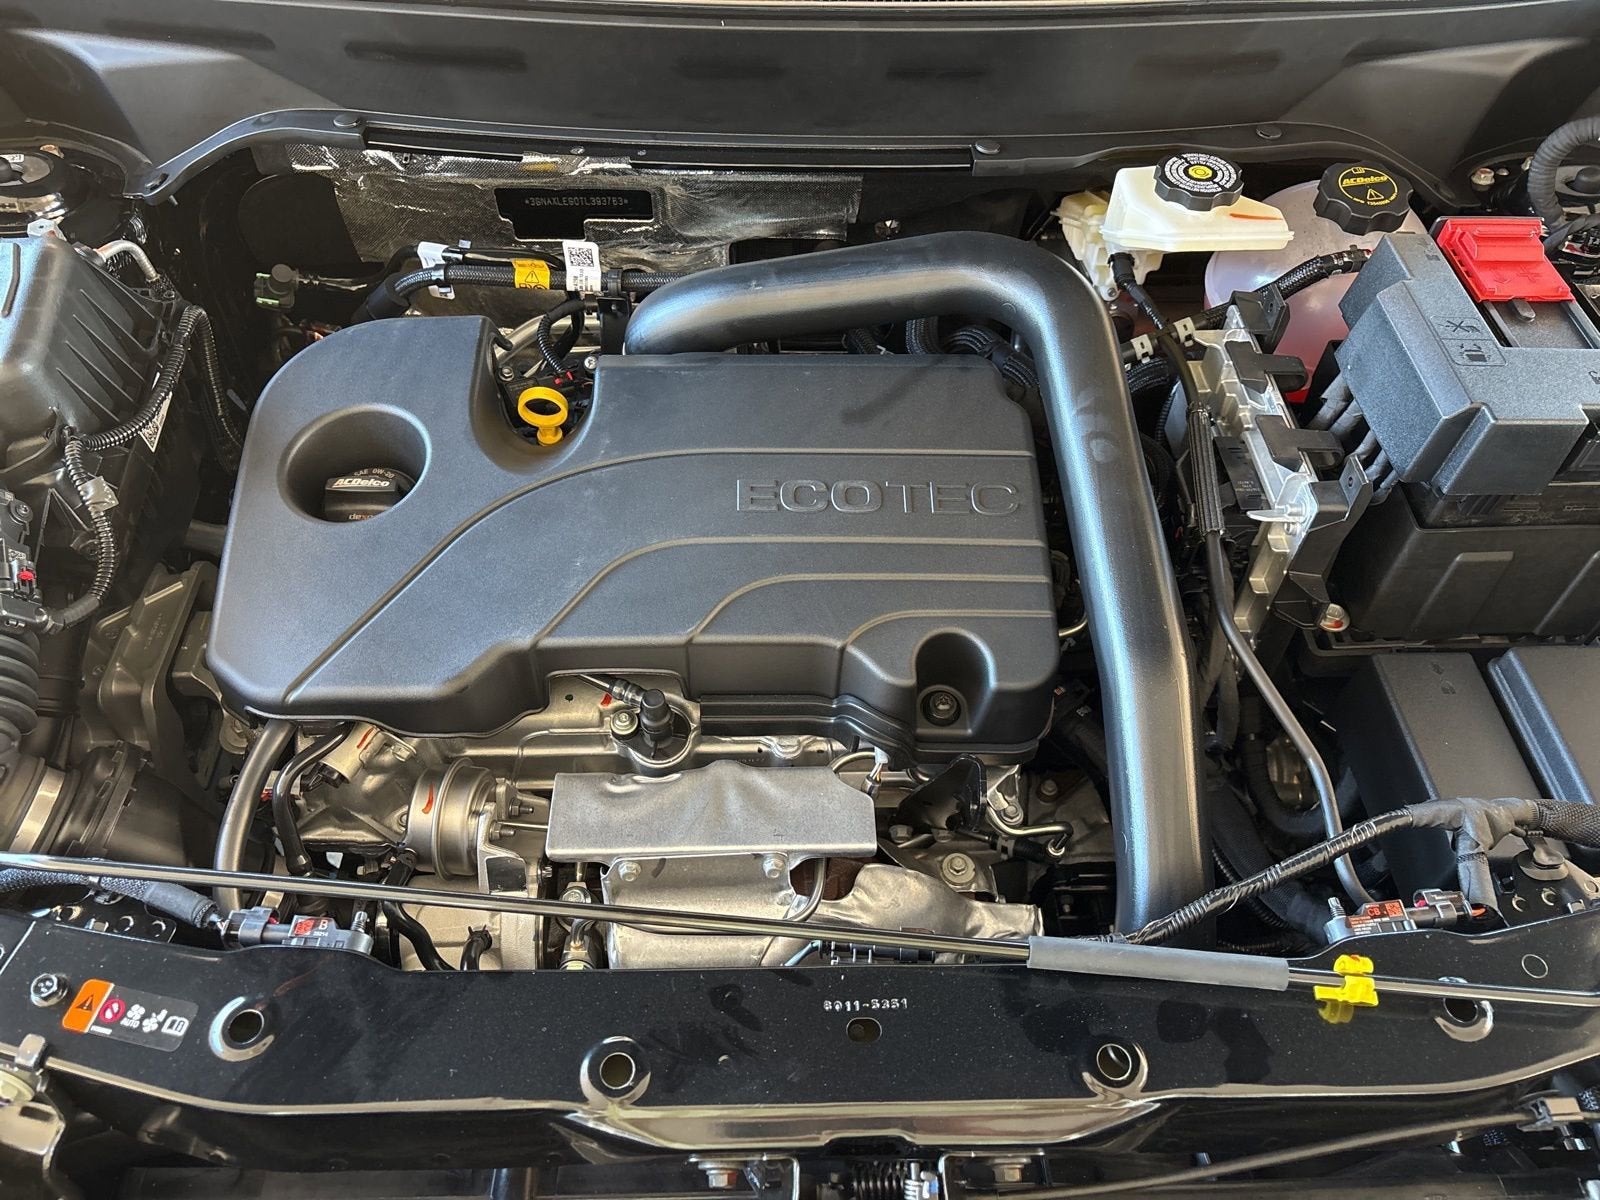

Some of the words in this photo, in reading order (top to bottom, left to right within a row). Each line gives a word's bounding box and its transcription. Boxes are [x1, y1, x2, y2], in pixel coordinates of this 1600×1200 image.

[1342, 175, 1388, 187] ACDelco
[353, 468, 369, 477] SAE
[372, 468, 396, 479] 0W-20
[332, 478, 390, 488] ACDelco
[736, 479, 1020, 516] ECOTEC
[348, 513, 375, 521] dexo
[318, 919, 329, 931] B
[119, 1017, 141, 1029] AUTO
